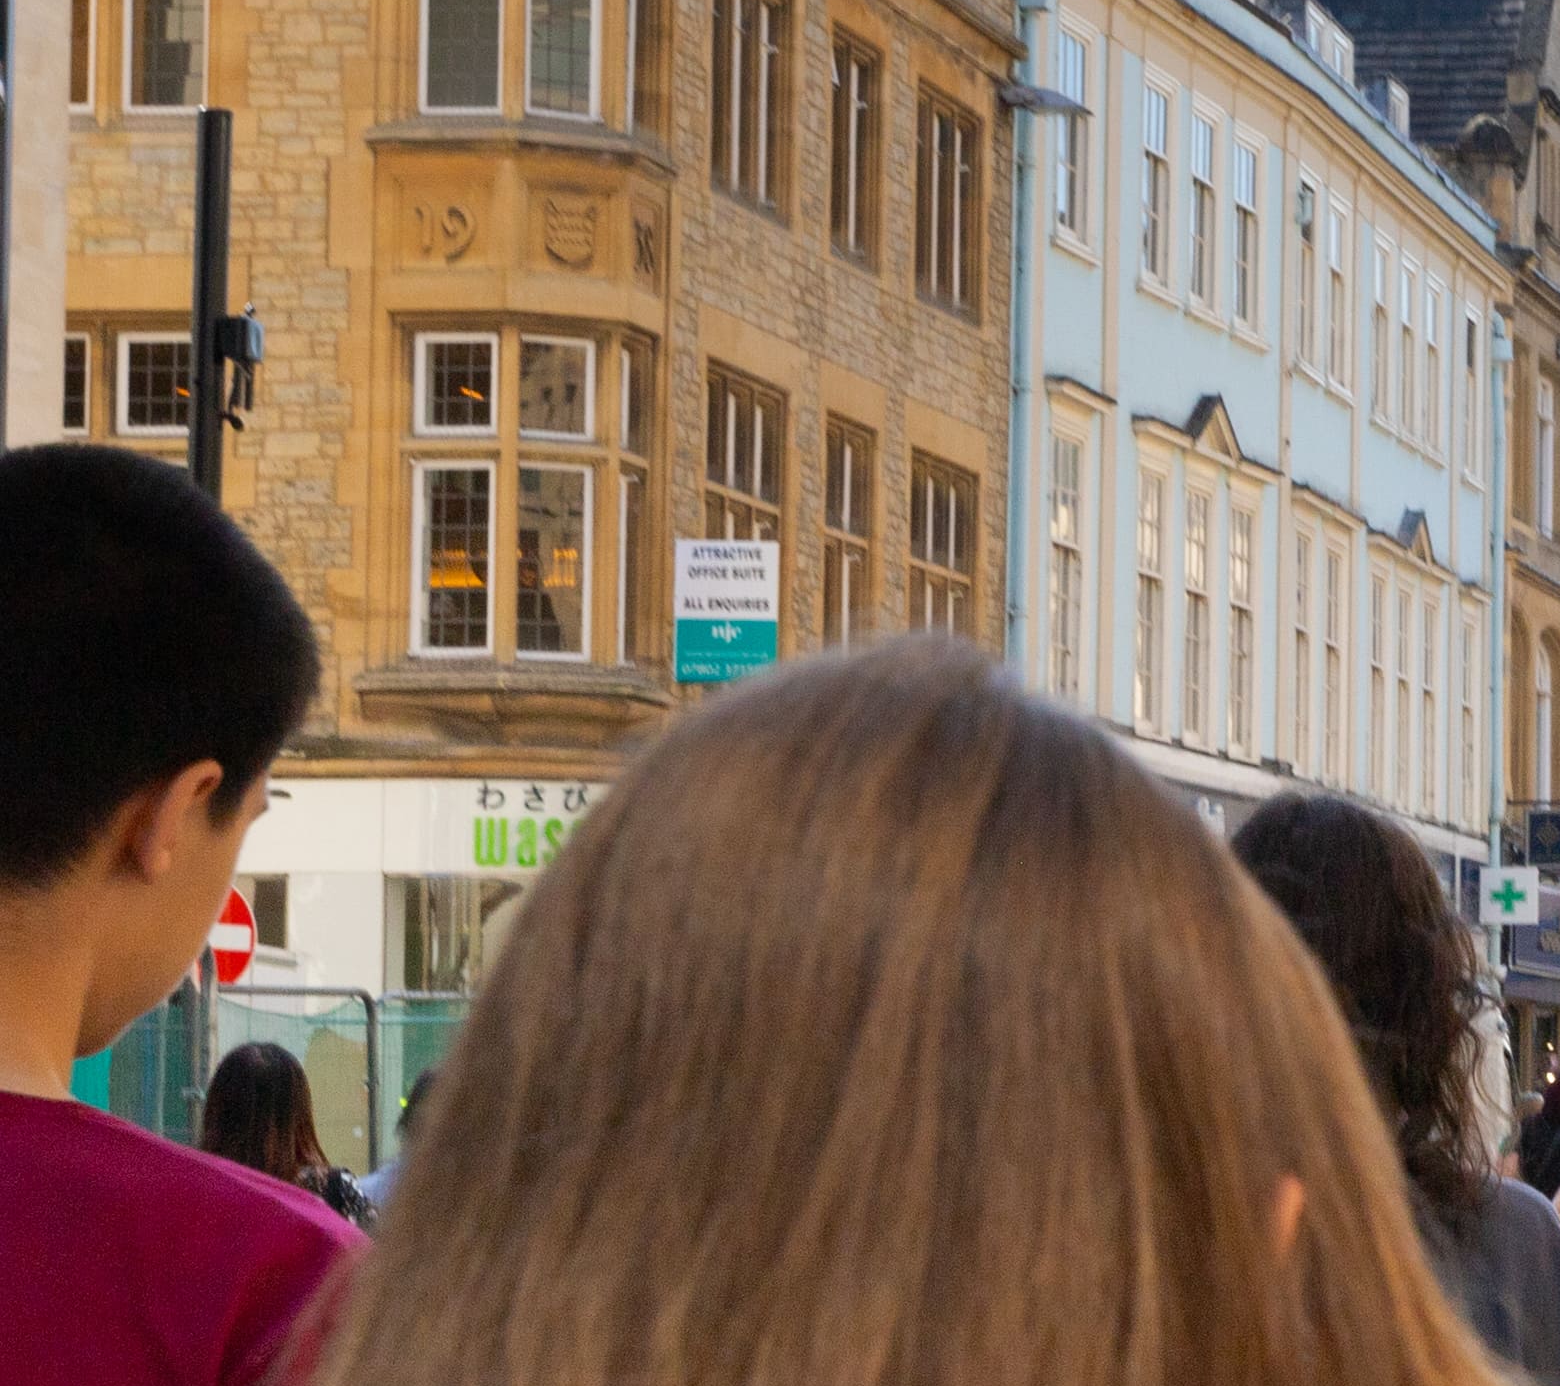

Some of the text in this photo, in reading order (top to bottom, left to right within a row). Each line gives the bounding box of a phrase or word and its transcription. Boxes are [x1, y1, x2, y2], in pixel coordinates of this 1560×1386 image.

[691, 547, 763, 561] ATTRACTIVE
[687, 565, 766, 581] OFFICE SUITE
[684, 597, 771, 613] ALL ENQUIRIES
[474, 816, 580, 868] was
